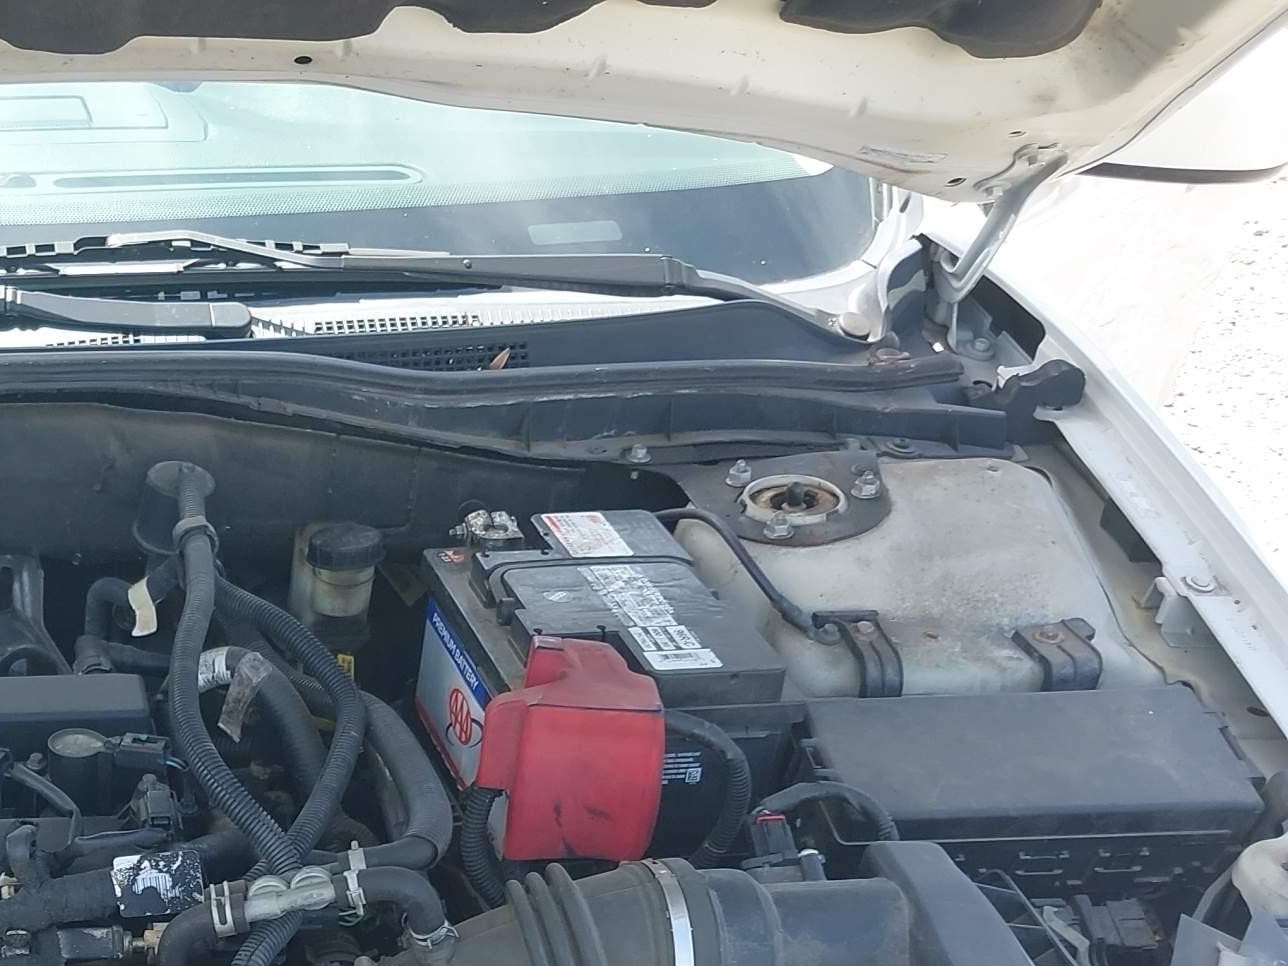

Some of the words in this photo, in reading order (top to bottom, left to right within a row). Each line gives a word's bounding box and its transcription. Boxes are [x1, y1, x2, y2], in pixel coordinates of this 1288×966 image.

[432, 612, 457, 656] PREMIUM
[454, 648, 479, 691] BATTERY
[450, 689, 472, 745] AAA
